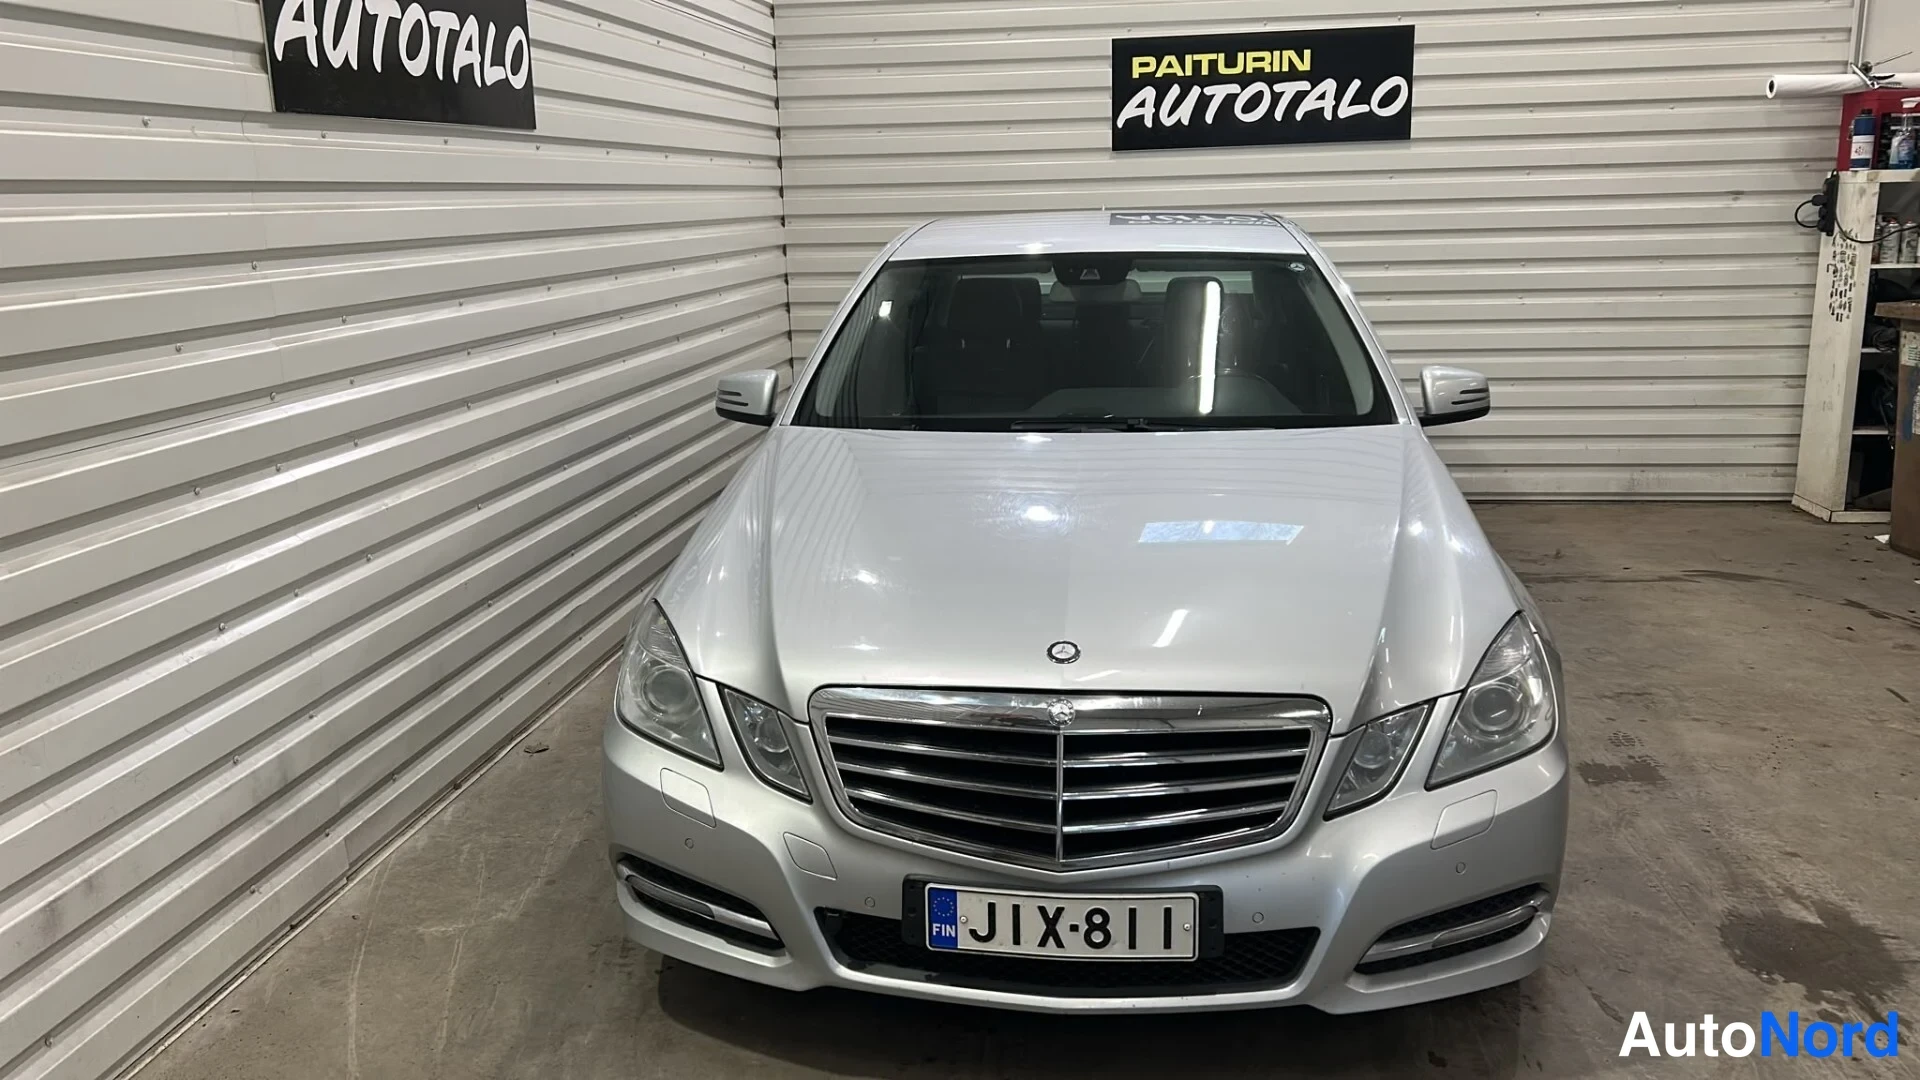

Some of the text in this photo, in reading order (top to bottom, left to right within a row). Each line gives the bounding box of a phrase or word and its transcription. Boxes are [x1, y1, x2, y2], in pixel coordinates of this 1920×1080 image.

[273, 0, 529, 90] AUTOTALO
[1131, 49, 1312, 79] PAITURIN
[1116, 76, 1409, 129] AUTOTALO
[932, 923, 956, 938] FIN
[968, 902, 1173, 950] JIX-811
